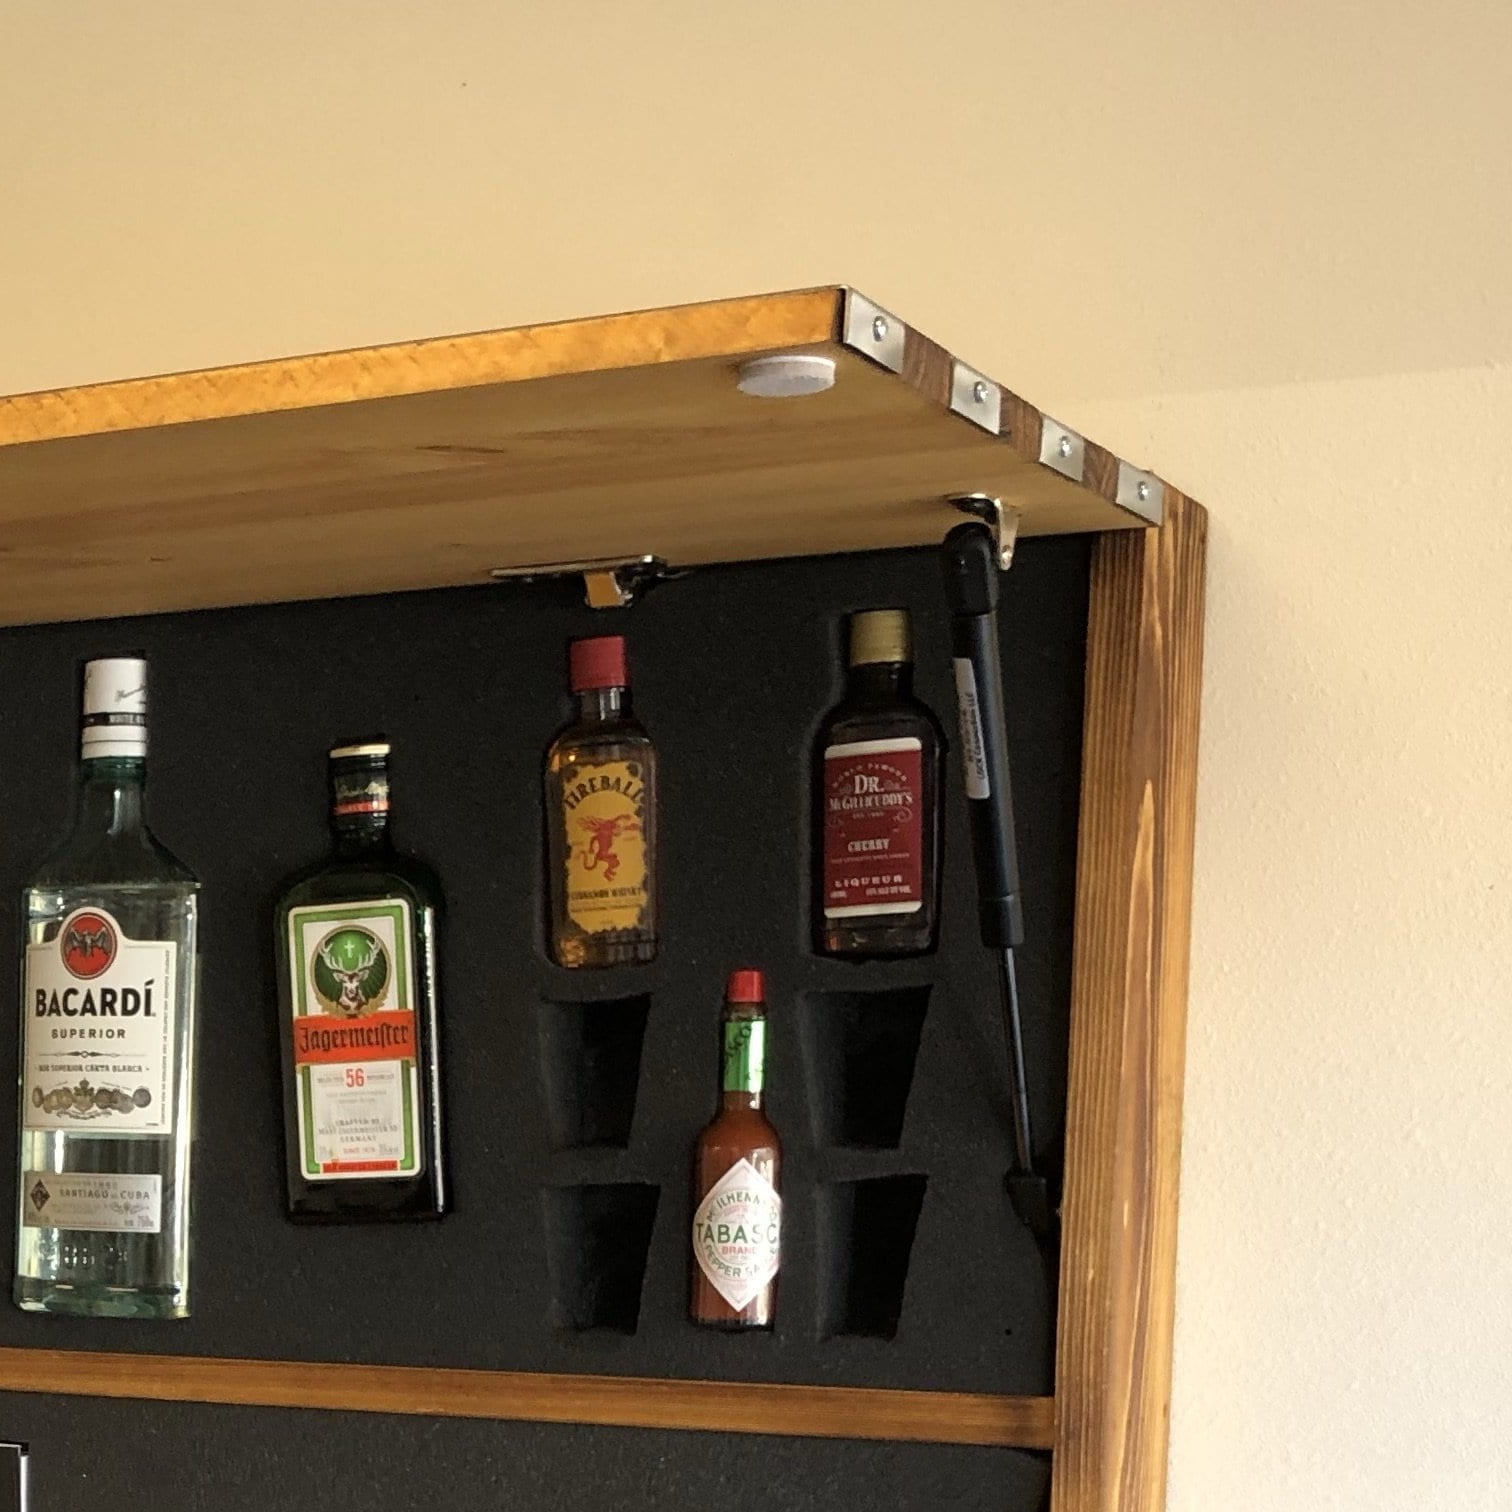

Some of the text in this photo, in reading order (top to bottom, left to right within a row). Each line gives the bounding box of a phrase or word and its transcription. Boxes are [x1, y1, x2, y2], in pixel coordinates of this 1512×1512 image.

[564, 775, 643, 811] FIREBALL
[35, 978, 155, 1018] BACARDÍ
[51, 1028, 127, 1039] SUPERIOR
[345, 1067, 365, 1088] 56
[120, 1190, 151, 1200] CUBA
